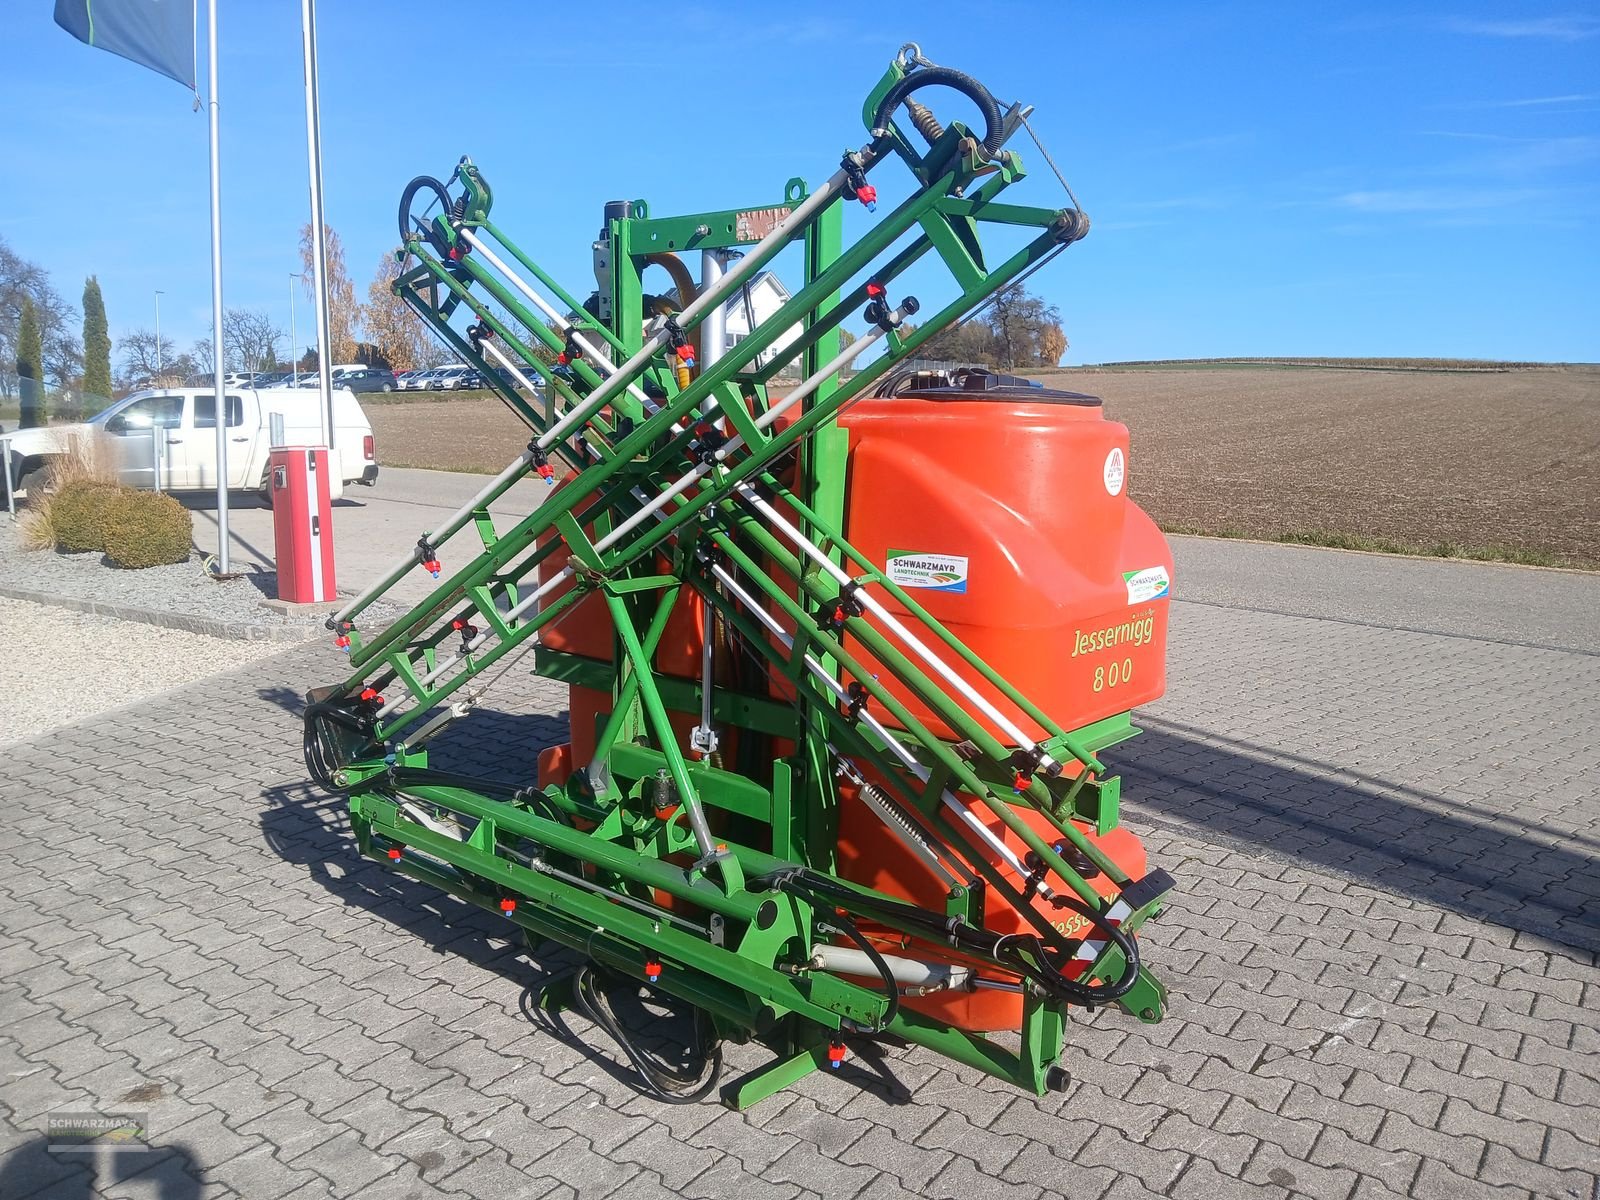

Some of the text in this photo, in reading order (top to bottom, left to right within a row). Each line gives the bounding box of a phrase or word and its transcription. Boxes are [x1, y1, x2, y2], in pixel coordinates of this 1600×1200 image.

[893, 558, 956, 573] SCHWARZMAYR
[894, 568, 930, 577] LANDTECHNIK
[1071, 613, 1154, 658] Jessernigg
[1092, 658, 1132, 692] 800
